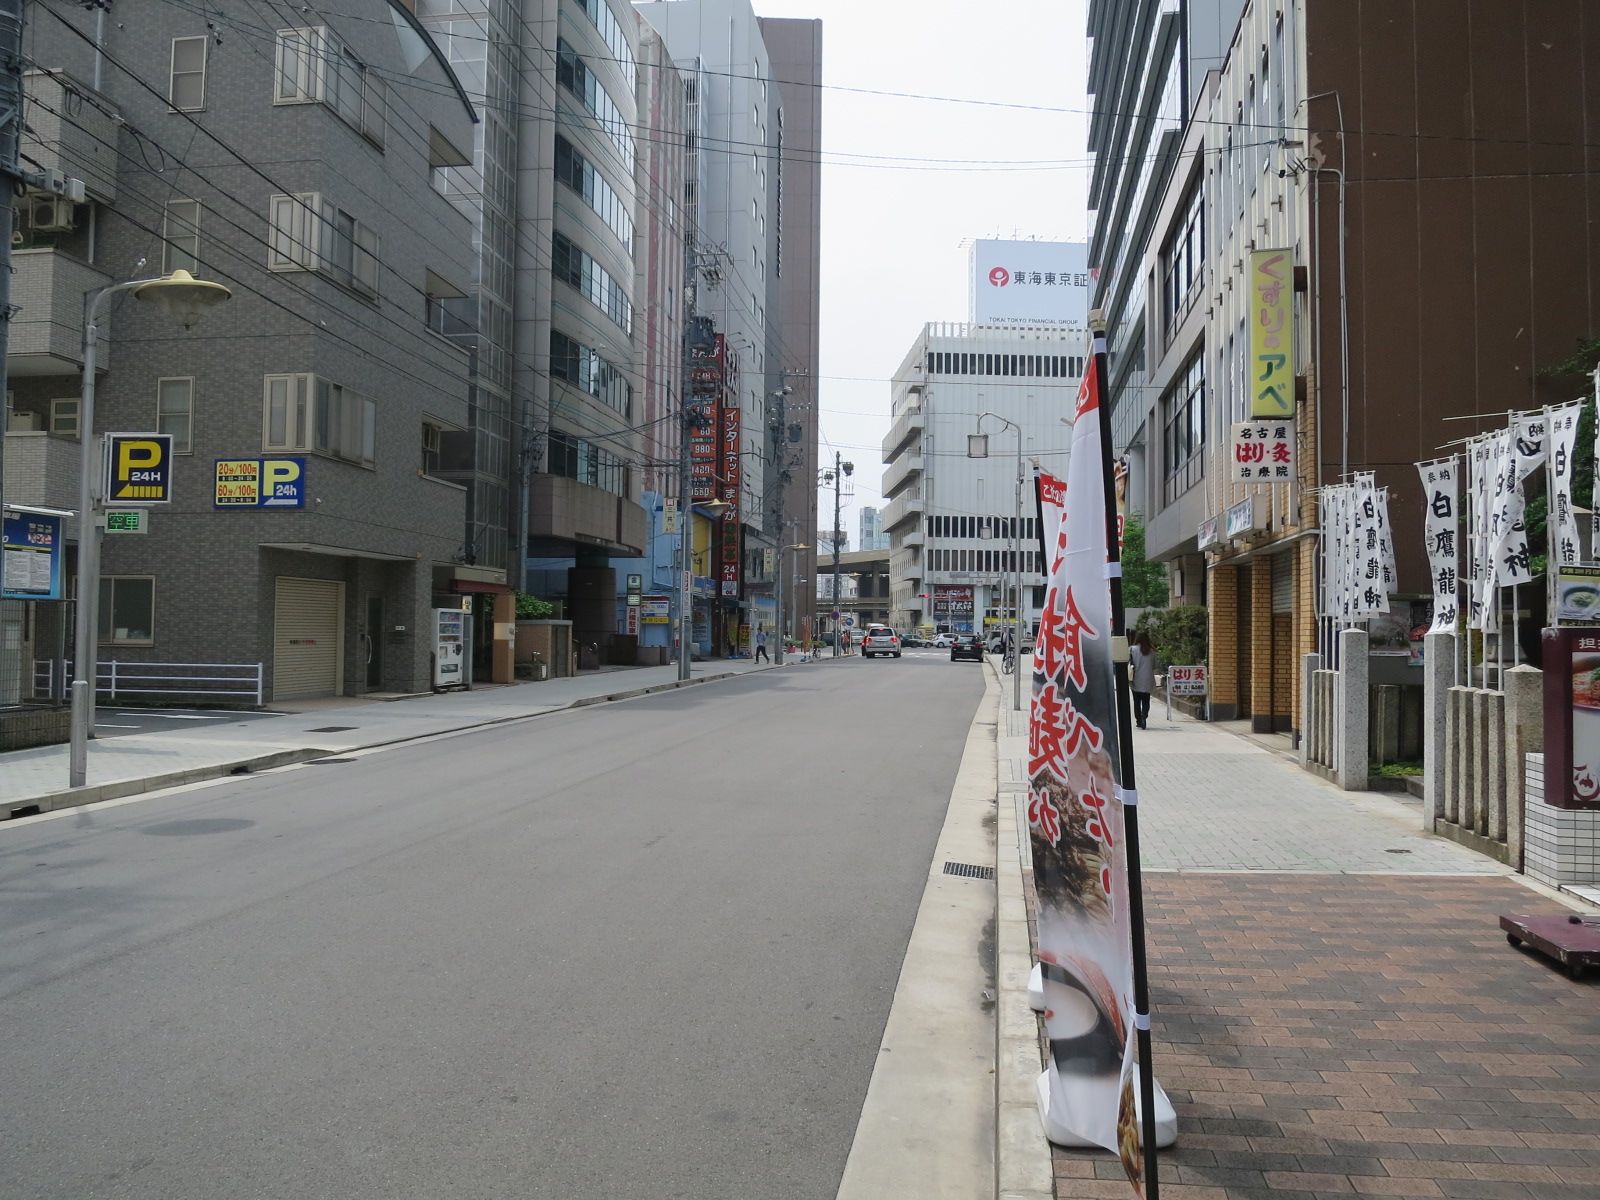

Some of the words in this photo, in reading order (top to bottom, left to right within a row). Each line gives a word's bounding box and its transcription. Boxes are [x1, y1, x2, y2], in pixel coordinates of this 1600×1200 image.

[1013, 271, 1088, 287] 東海東京証
[1258, 254, 1288, 410] くすりのアベ
[1240, 427, 1287, 439] 名古屋
[726, 410, 738, 482] インターネット
[118, 441, 162, 481] P
[131, 472, 160, 481] 24H
[263, 461, 300, 496] P
[1241, 466, 1289, 478] 治療院
[1427, 469, 1451, 483] 奉納
[276, 484, 297, 496] 24h
[725, 488, 736, 520] まんが
[108, 512, 141, 531] 空車
[1431, 490, 1456, 626] 白鷹龍神
[723, 565, 736, 573] 24
[1578, 637, 1600, 649] 担
